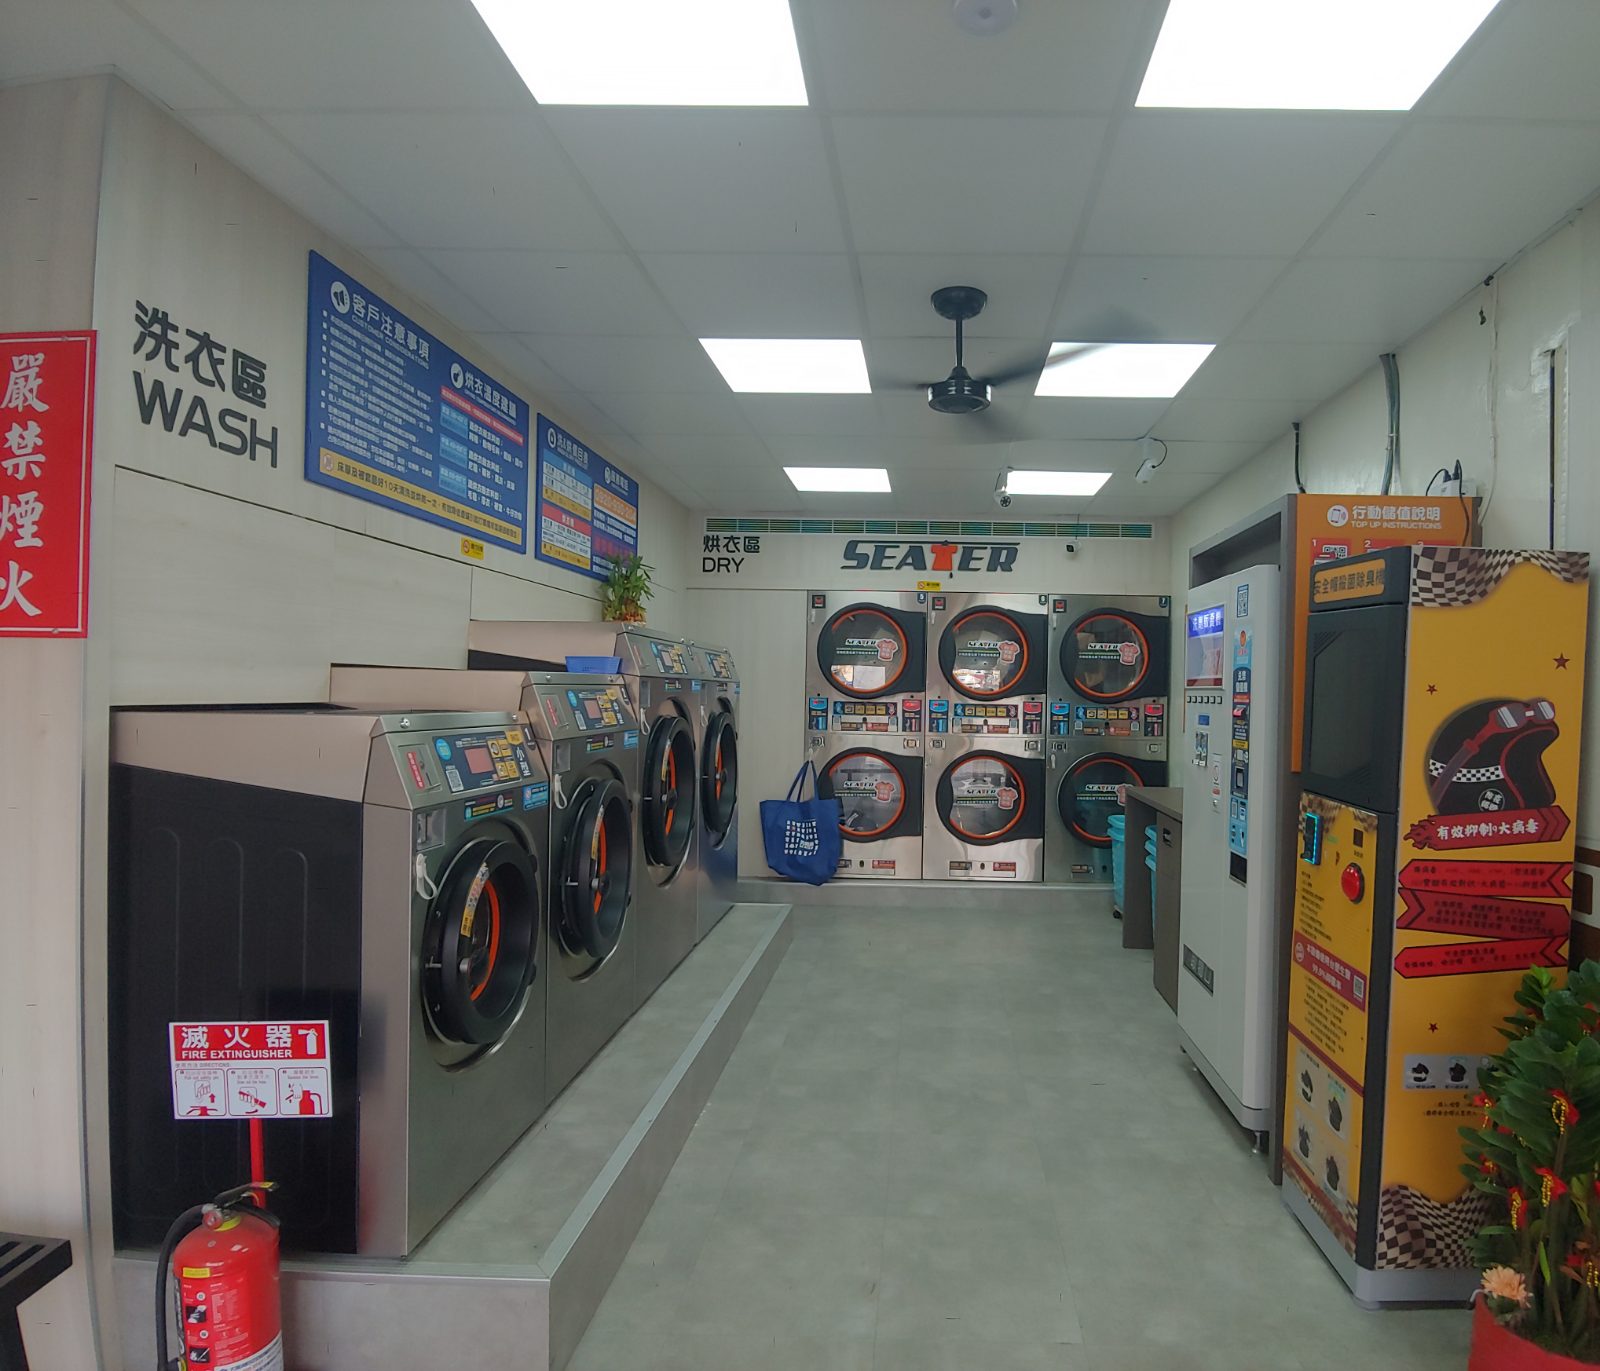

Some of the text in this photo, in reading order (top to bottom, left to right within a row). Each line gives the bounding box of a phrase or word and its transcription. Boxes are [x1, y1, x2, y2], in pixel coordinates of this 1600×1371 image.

[133, 299, 266, 408] 洗衣區
[133, 370, 278, 468] WASH
[0, 352, 49, 617] 嚴禁煙火
[1352, 504, 1441, 521] 行動儲值說明
[1351, 520, 1442, 530] TOP UP INSTRUCTIONS
[703, 534, 761, 554] 烘衣區
[702, 557, 745, 573] DRY
[840, 540, 1021, 572] SEATER
[181, 1025, 293, 1049] 滅火器
[181, 1049, 293, 1060] FIRE EXTINGUISHER
